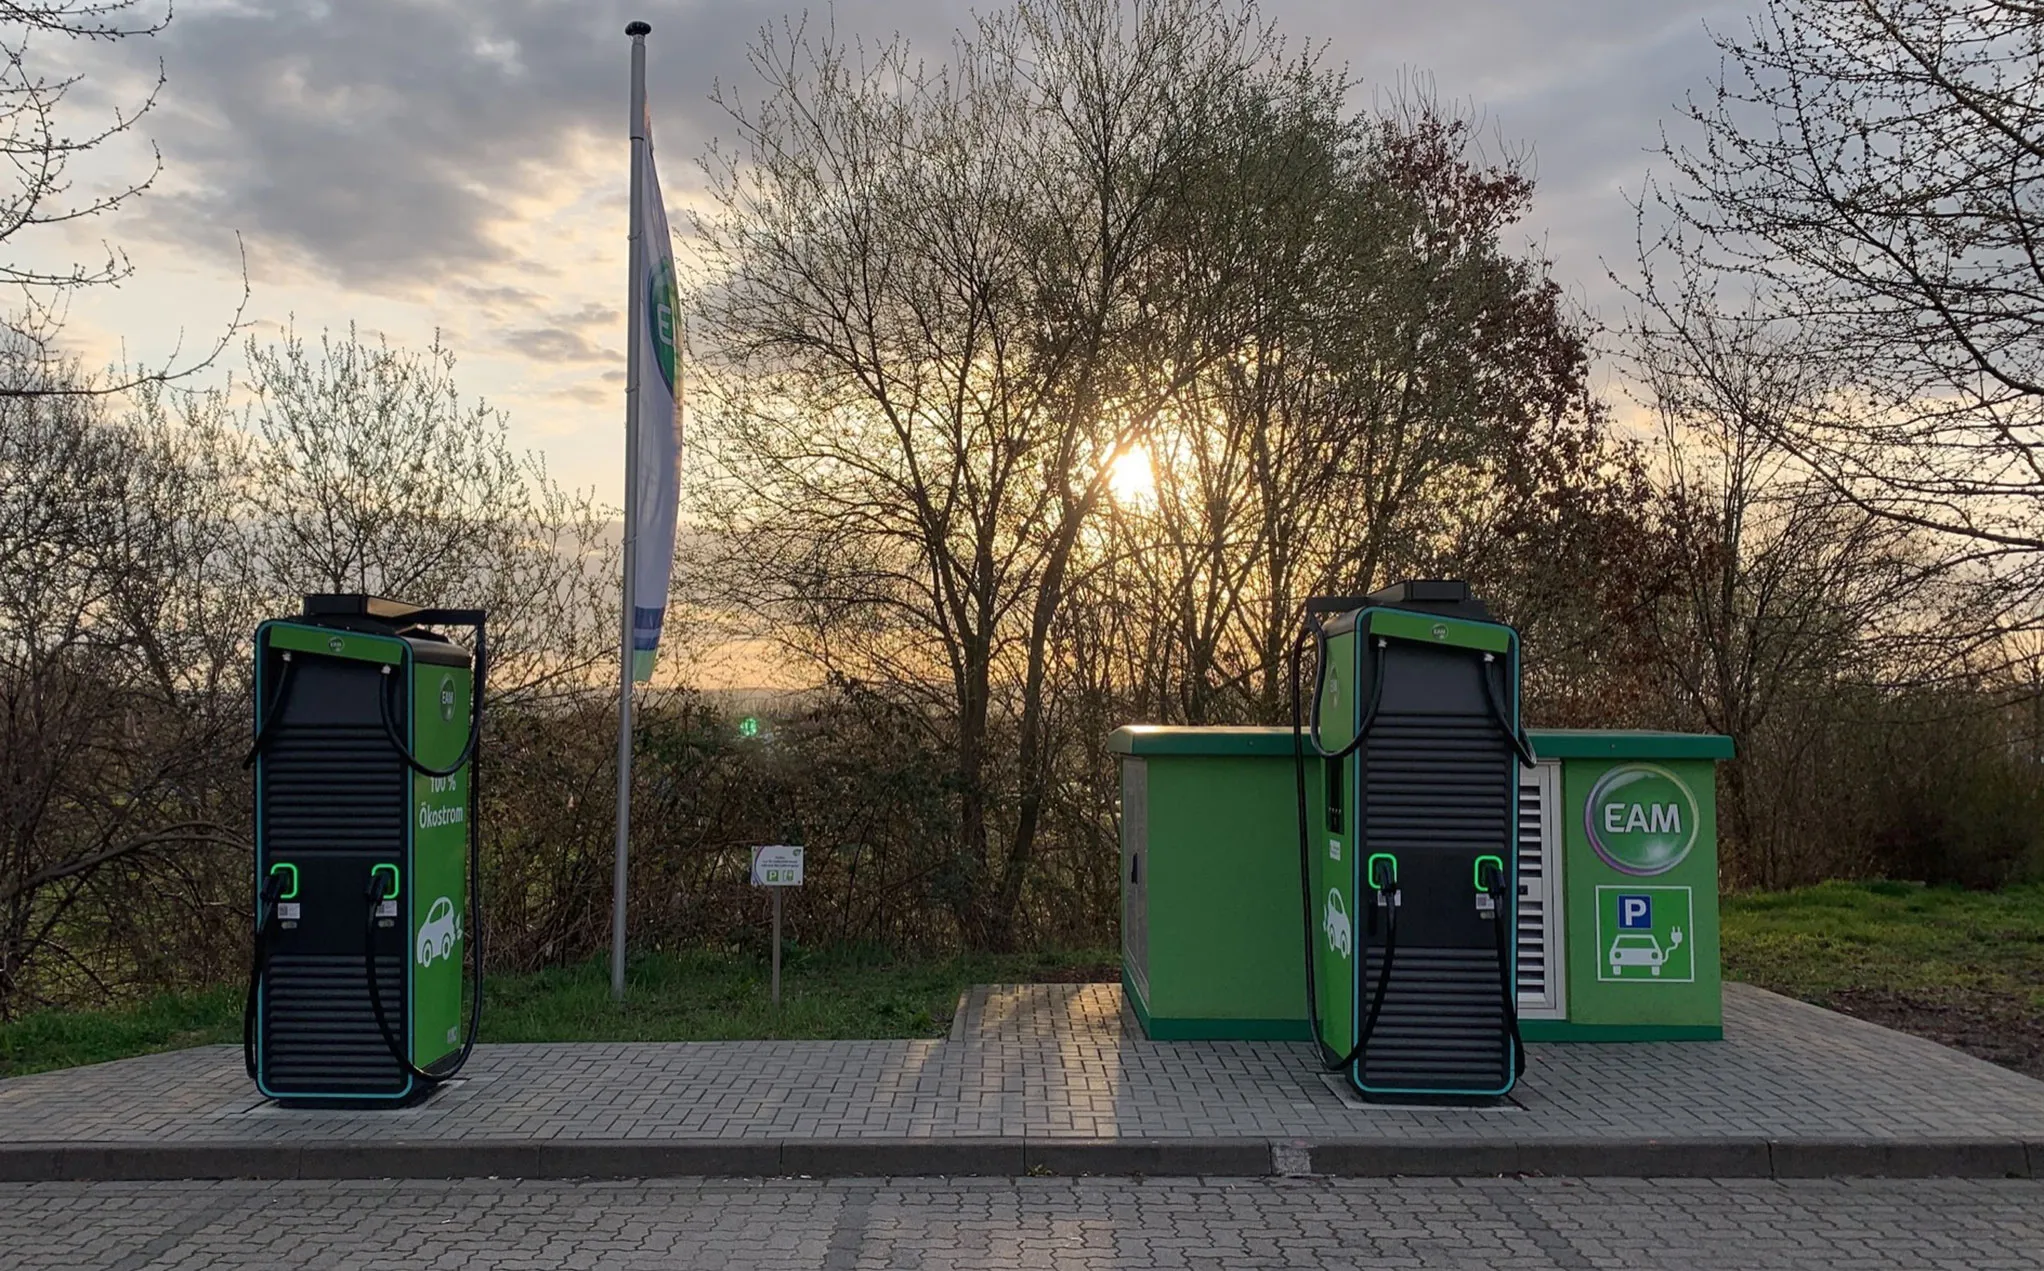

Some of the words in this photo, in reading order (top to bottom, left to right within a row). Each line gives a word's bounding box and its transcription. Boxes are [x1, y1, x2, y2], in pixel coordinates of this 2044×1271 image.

[430, 776, 446, 793] 100
[419, 801, 464, 829] Ökostrom
[1604, 803, 1681, 833] EAM
[1624, 898, 1647, 926] P
